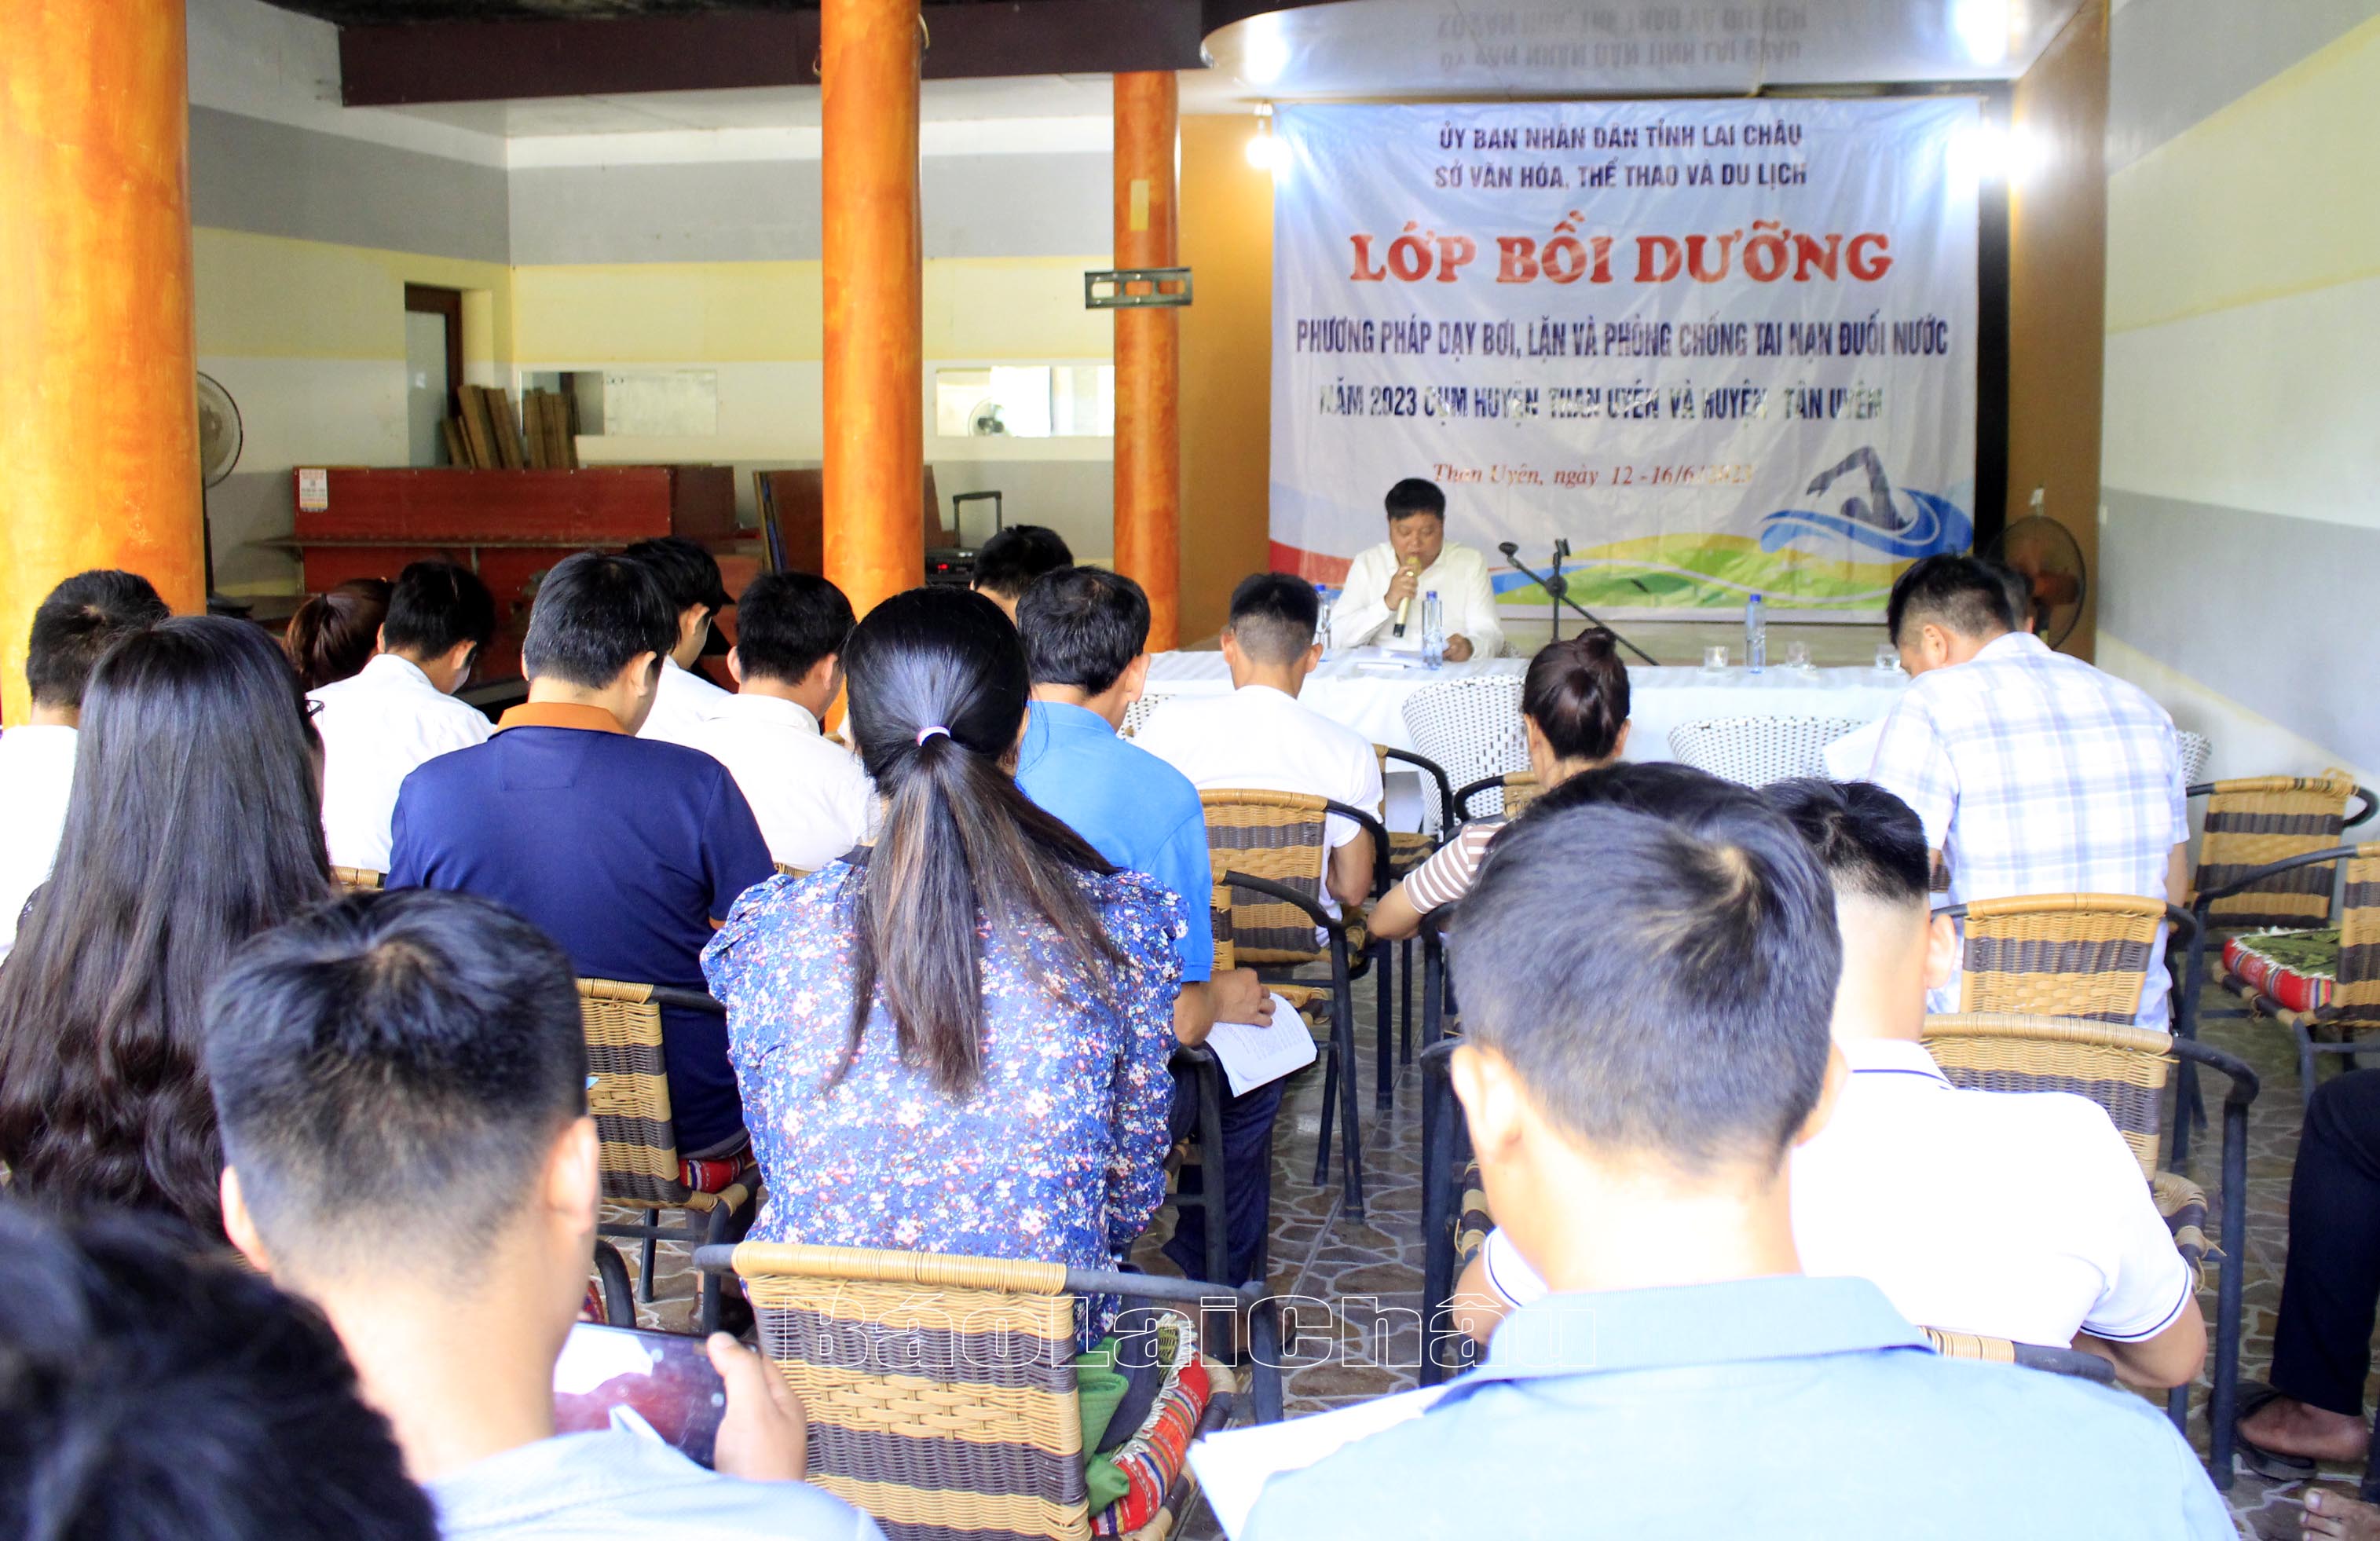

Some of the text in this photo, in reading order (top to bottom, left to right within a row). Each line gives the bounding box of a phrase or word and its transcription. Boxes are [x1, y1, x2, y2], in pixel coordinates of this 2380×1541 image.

[1440, 118, 1802, 149] ỦY BAN NHÂN DÂN TỈNH LAI CHÂU
[1435, 156, 1807, 190] SỞ VĂN HÓA, THỂ THAO VÀ DU LỊCH
[1349, 210, 1894, 284] LỚP BỒI DƯỠNG
[1296, 308, 1948, 364] PHƯƠNG PHÁP DẠY BƠI, LẶN VÀ PHÒNG CHỐNG TAI NẠN ĐUỐI NƯỚC
[1320, 376, 1364, 416] NĂM
[1371, 384, 1417, 417] 2023
[1424, 385, 1468, 426] CỤM
[1474, 379, 1540, 428] HUYỆN
[1670, 379, 1695, 419] VÀ
[1784, 379, 1824, 419] TÂN
[1433, 463, 1483, 484] Than
[1554, 463, 1599, 490] ngày
[1612, 465, 1633, 485] 12
